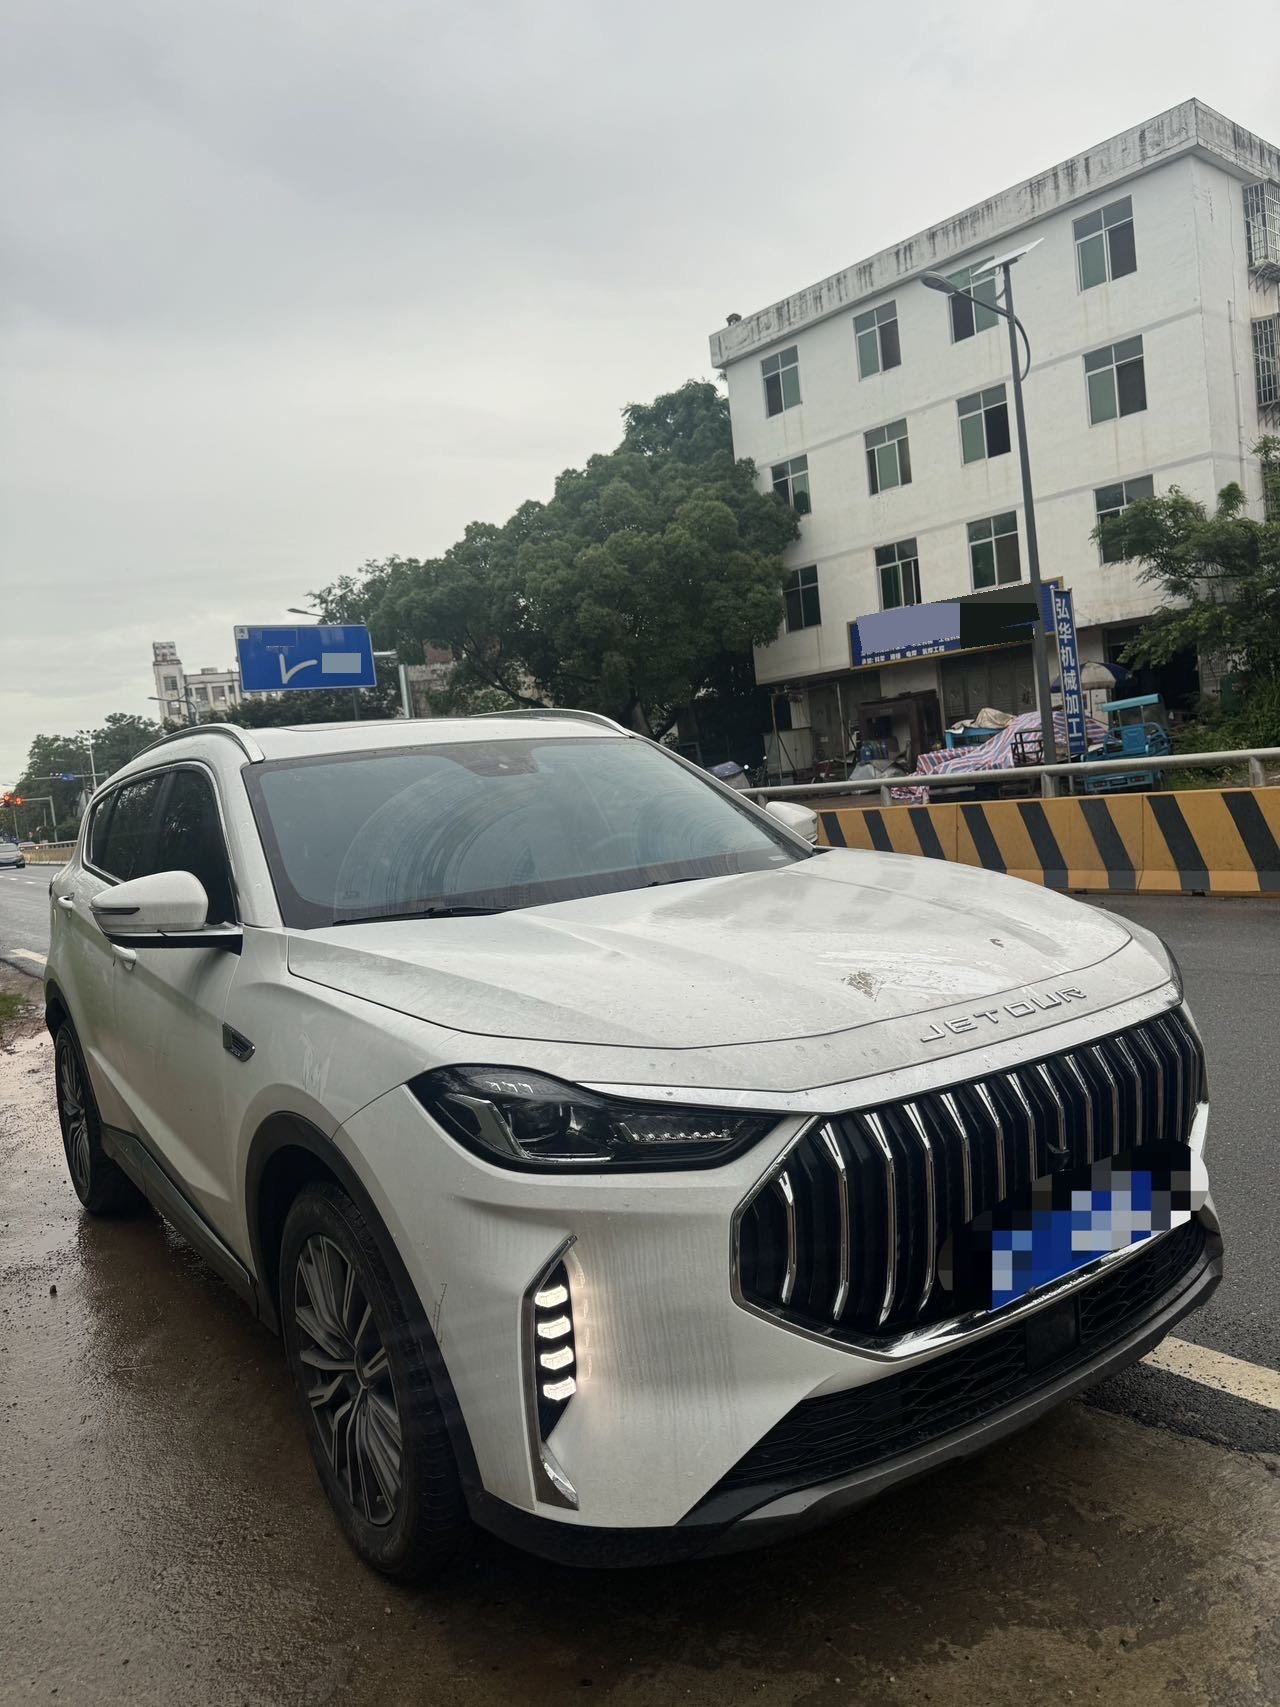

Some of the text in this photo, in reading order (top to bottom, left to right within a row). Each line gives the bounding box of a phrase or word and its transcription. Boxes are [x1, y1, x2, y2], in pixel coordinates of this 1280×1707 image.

[1055, 598, 1082, 737] 弘华机械加工
[920, 986, 1087, 1043] JETOUR
